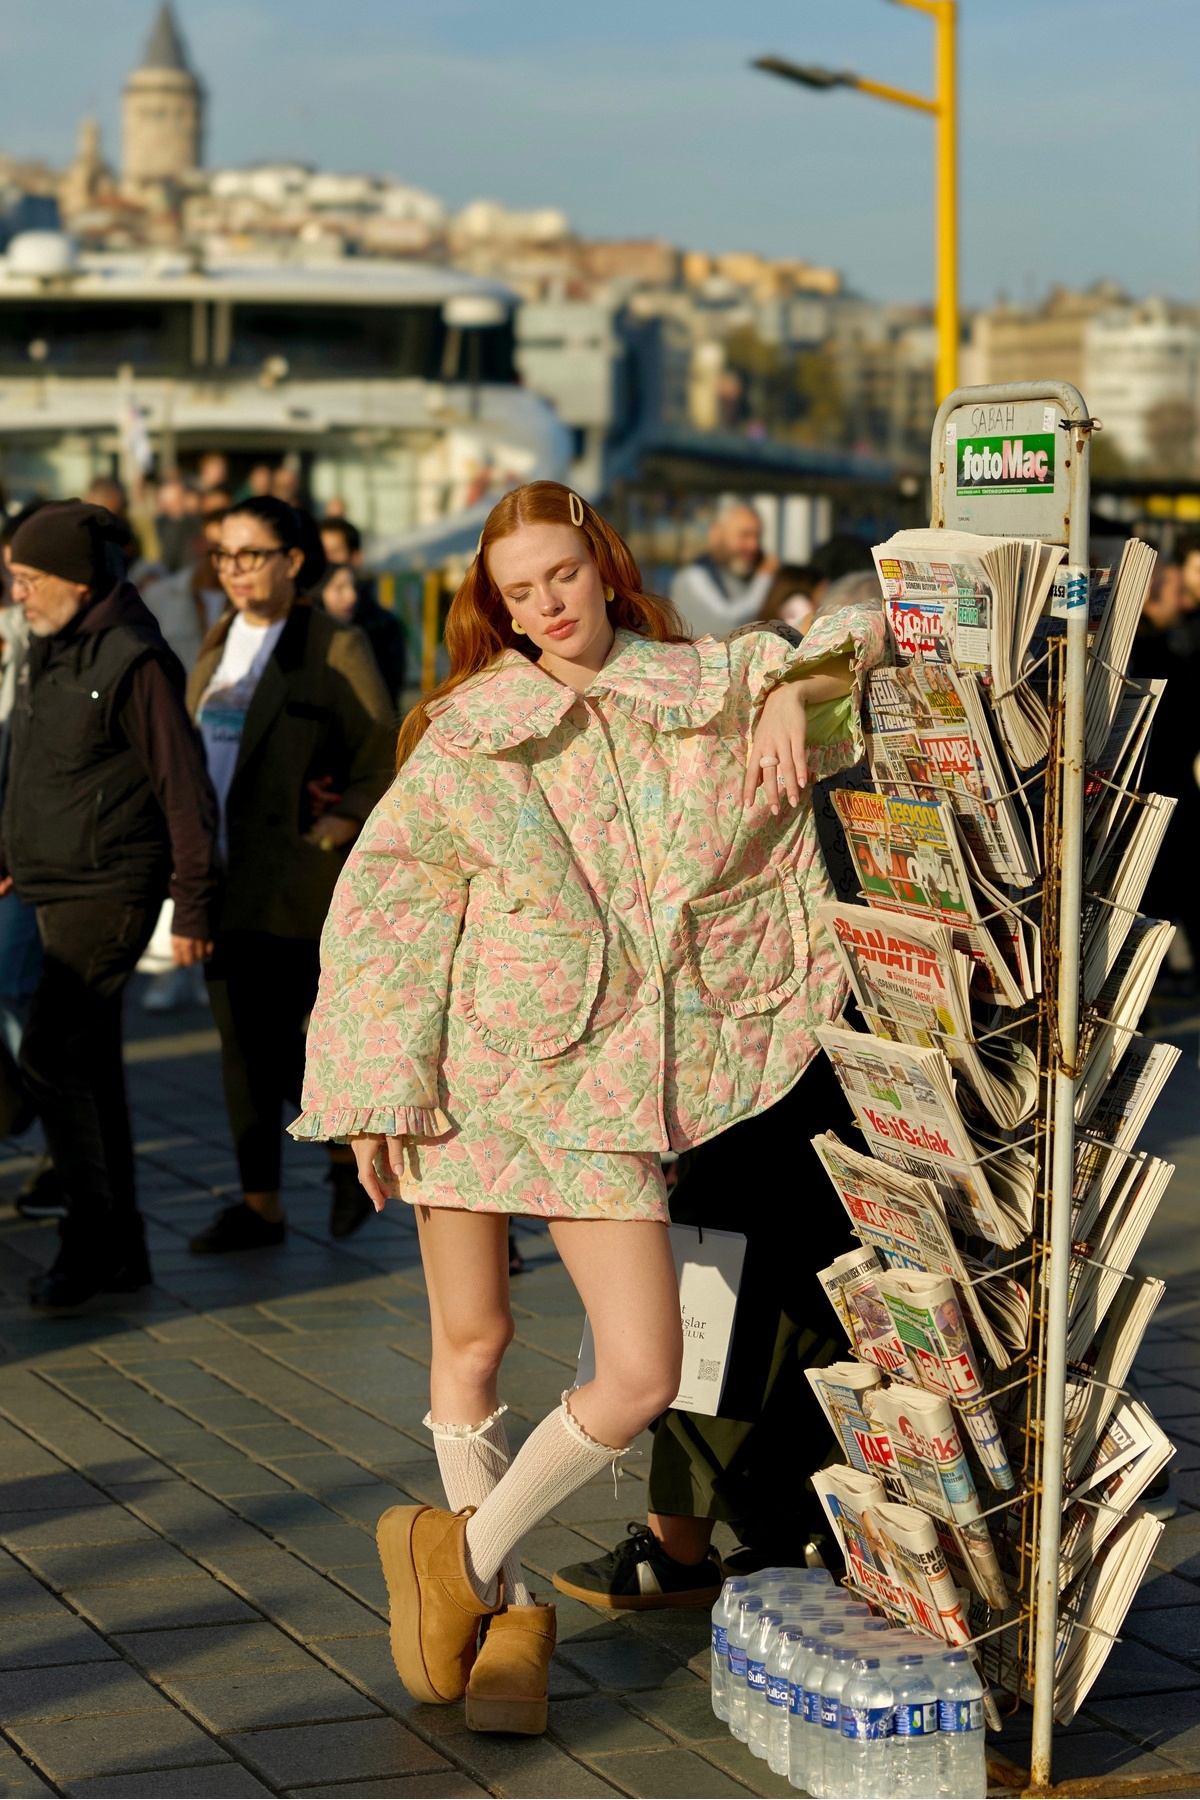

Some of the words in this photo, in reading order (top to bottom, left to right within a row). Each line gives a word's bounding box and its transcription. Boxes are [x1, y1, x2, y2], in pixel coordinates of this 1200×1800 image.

[970, 406, 1015, 437] SABAH
[962, 440, 1048, 482] fotoMaç
[893, 611, 942, 647] SABAH
[887, 800, 942, 830] RÜDİGER
[861, 1201, 917, 1241] AKŞAM
